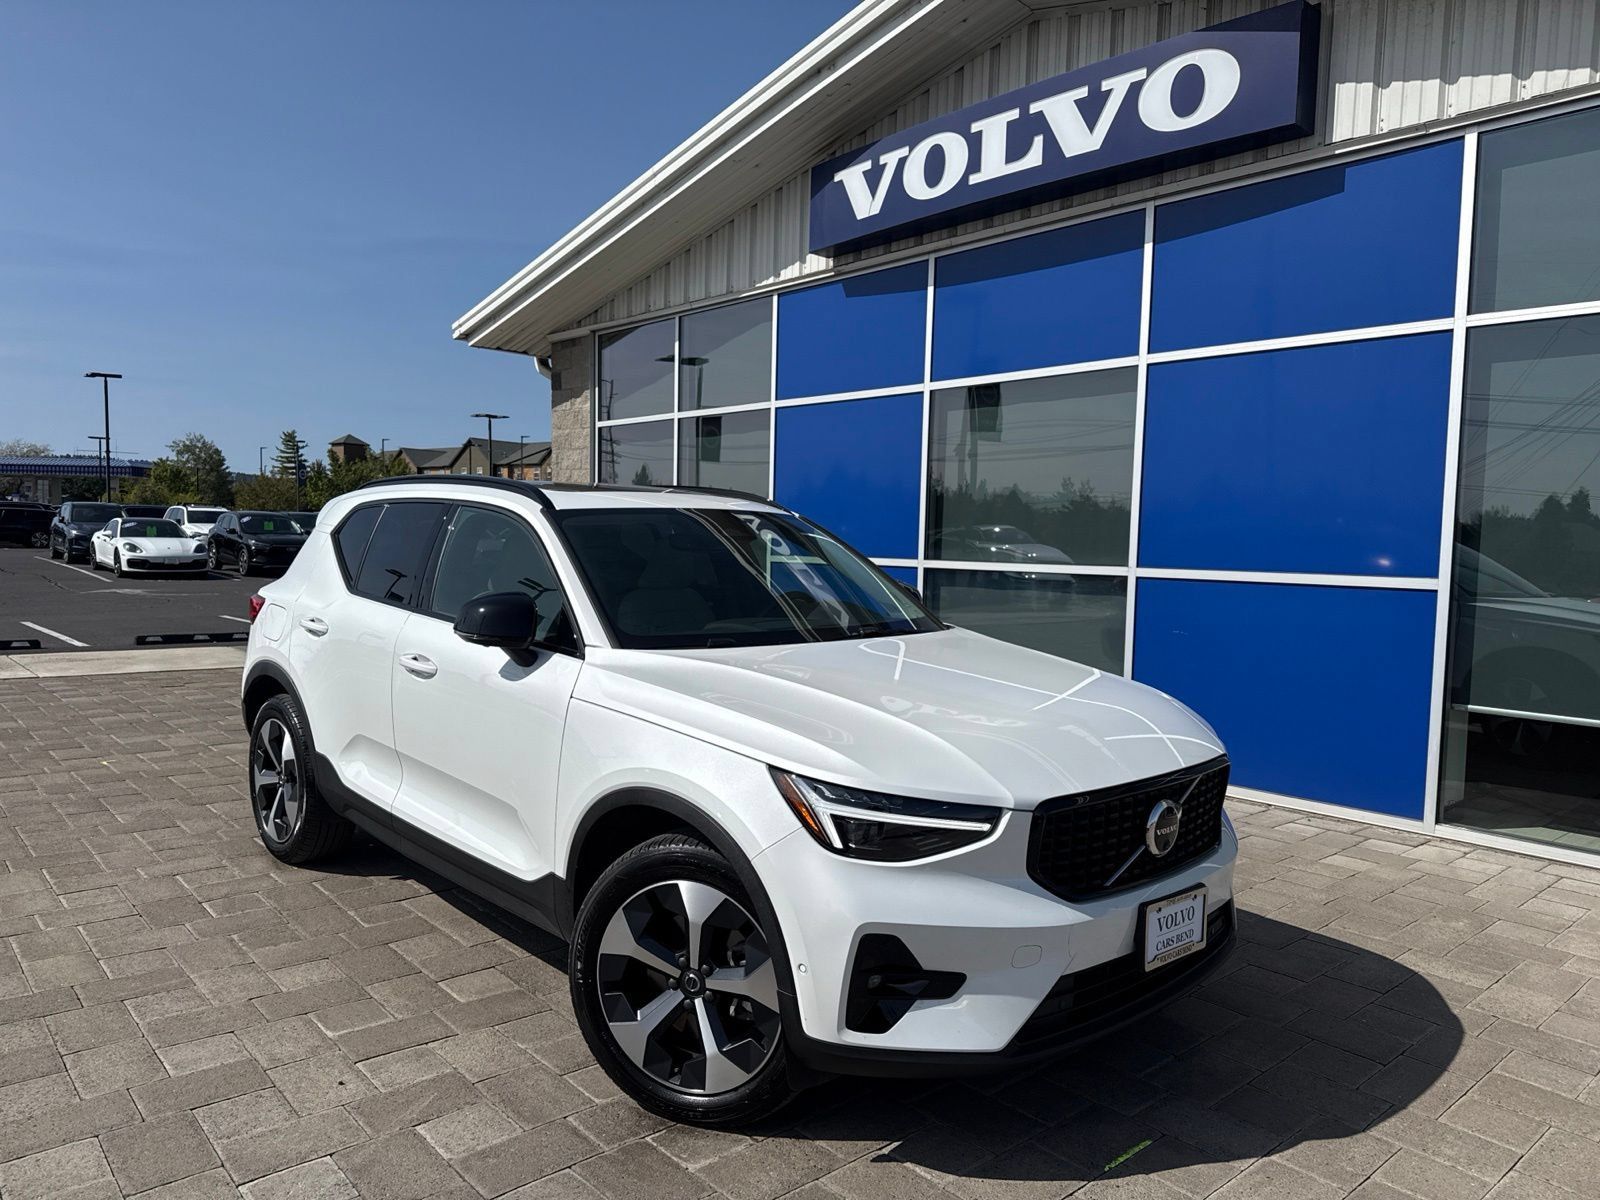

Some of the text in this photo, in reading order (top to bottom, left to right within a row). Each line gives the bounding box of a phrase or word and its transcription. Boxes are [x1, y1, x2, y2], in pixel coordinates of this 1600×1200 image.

[833, 48, 1241, 220] VOLVO
[1157, 905, 1195, 932] VOLVO
[1156, 928, 1194, 952] CARS BEND
